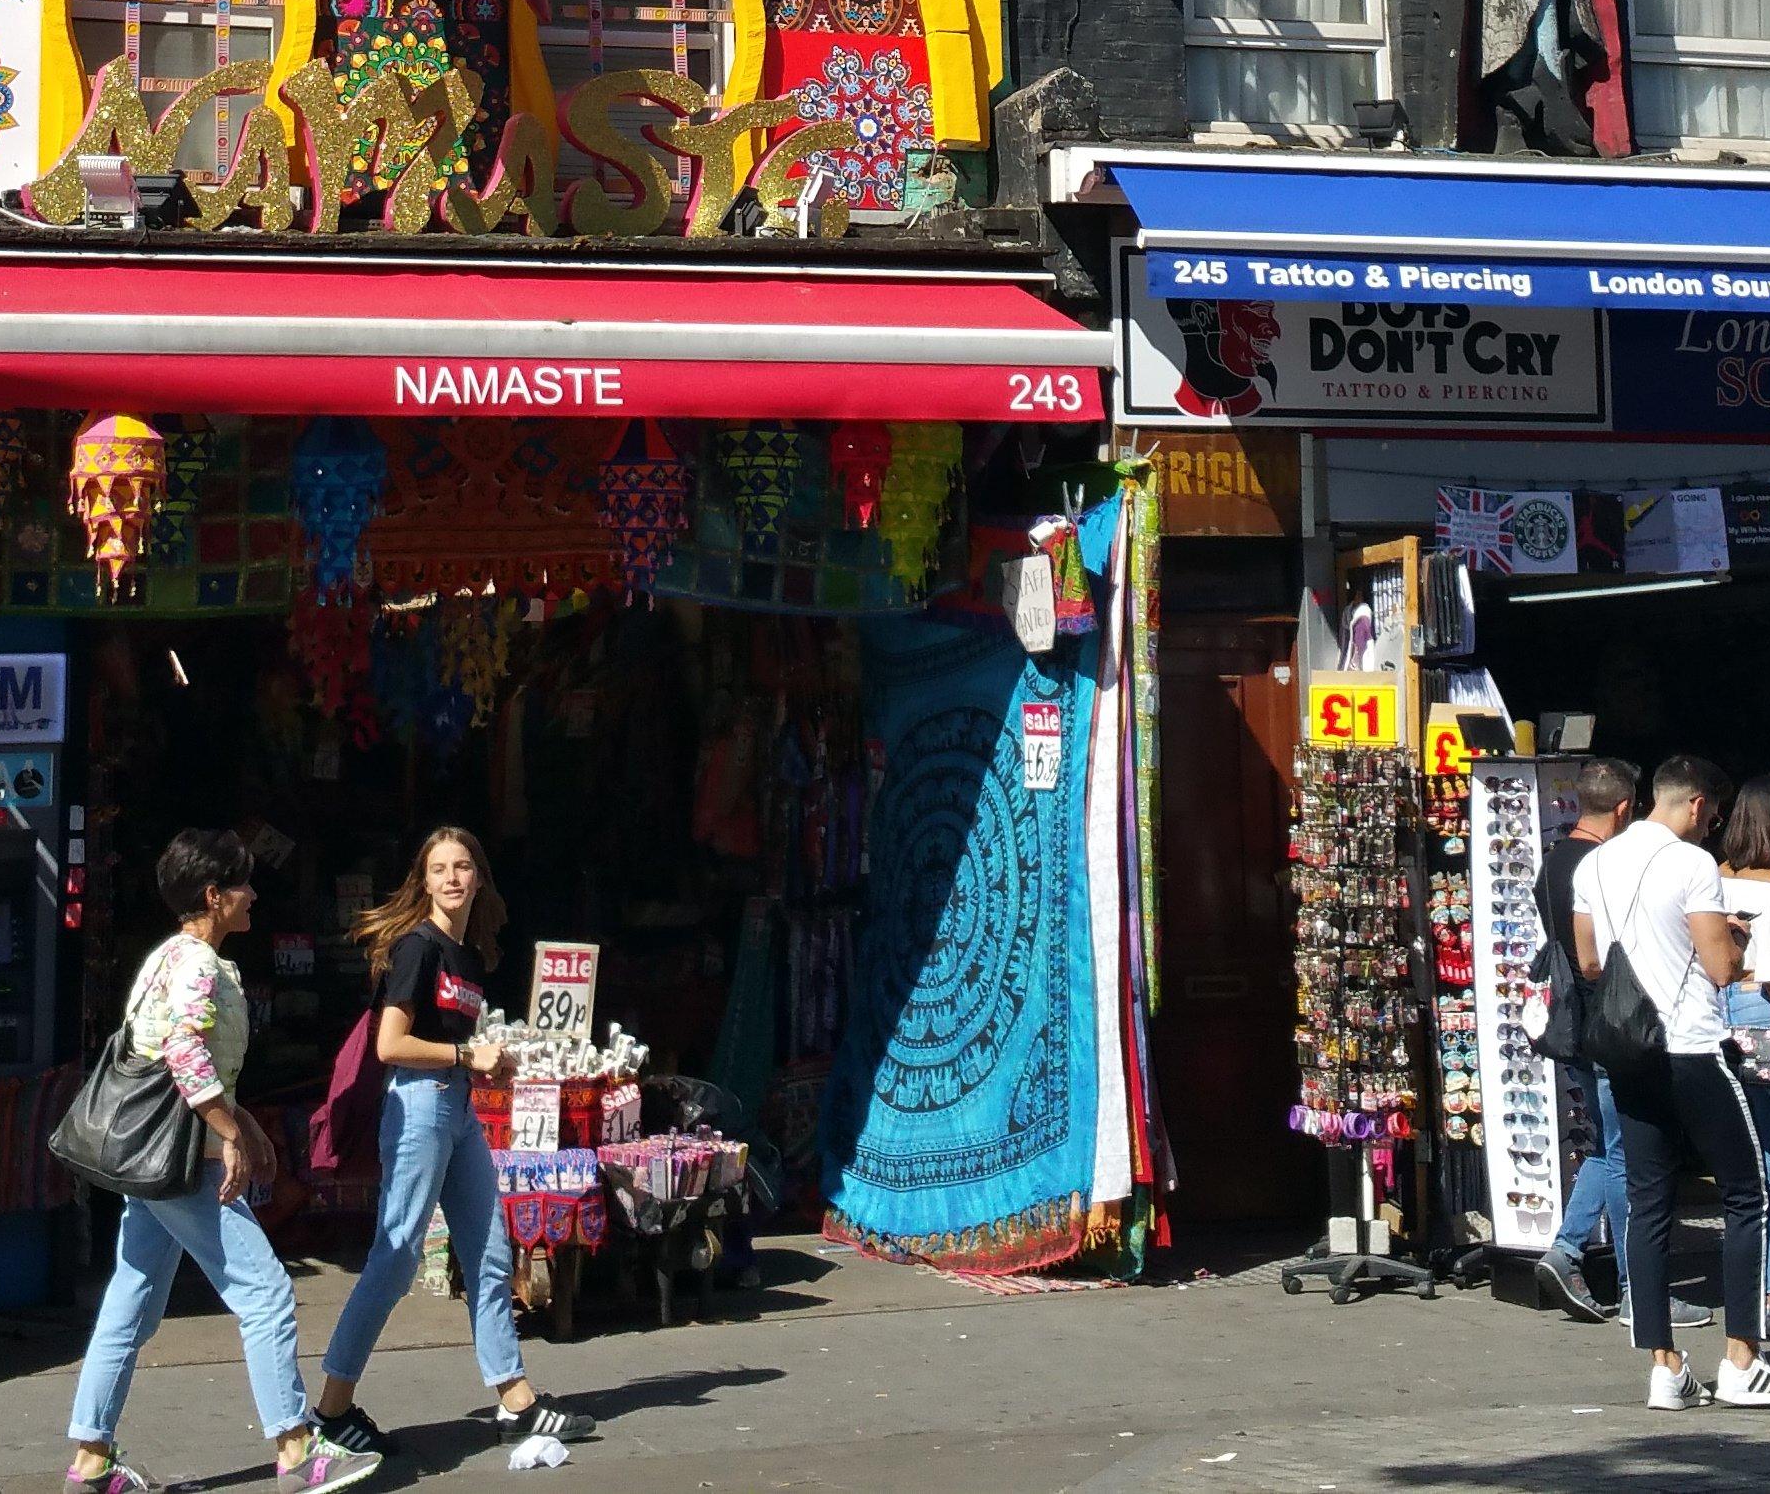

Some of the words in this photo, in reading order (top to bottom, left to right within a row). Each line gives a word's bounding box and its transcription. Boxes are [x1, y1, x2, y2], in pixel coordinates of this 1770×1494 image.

[1174, 260, 1228, 285] 245
[1247, 261, 1355, 288] Tattoo
[1364, 264, 1391, 290] &
[1400, 265, 1532, 298] Piercing
[1589, 270, 1704, 298] London
[1309, 317, 1455, 375] DON'T
[1462, 320, 1561, 376] CRY
[395, 366, 624, 407] NAMASTE
[1009, 374, 1084, 414] 243
[1322, 382, 1408, 399] TATTOO
[1418, 383, 1431, 400] &
[1442, 384, 1549, 402] PIERCING
[1515, 501, 1568, 529] STARBUCKS
[1521, 542, 1562, 560] COFFEE
[1016, 608, 1052, 639] ANTED
[1319, 692, 1380, 739] £1
[542, 953, 593, 979] sale
